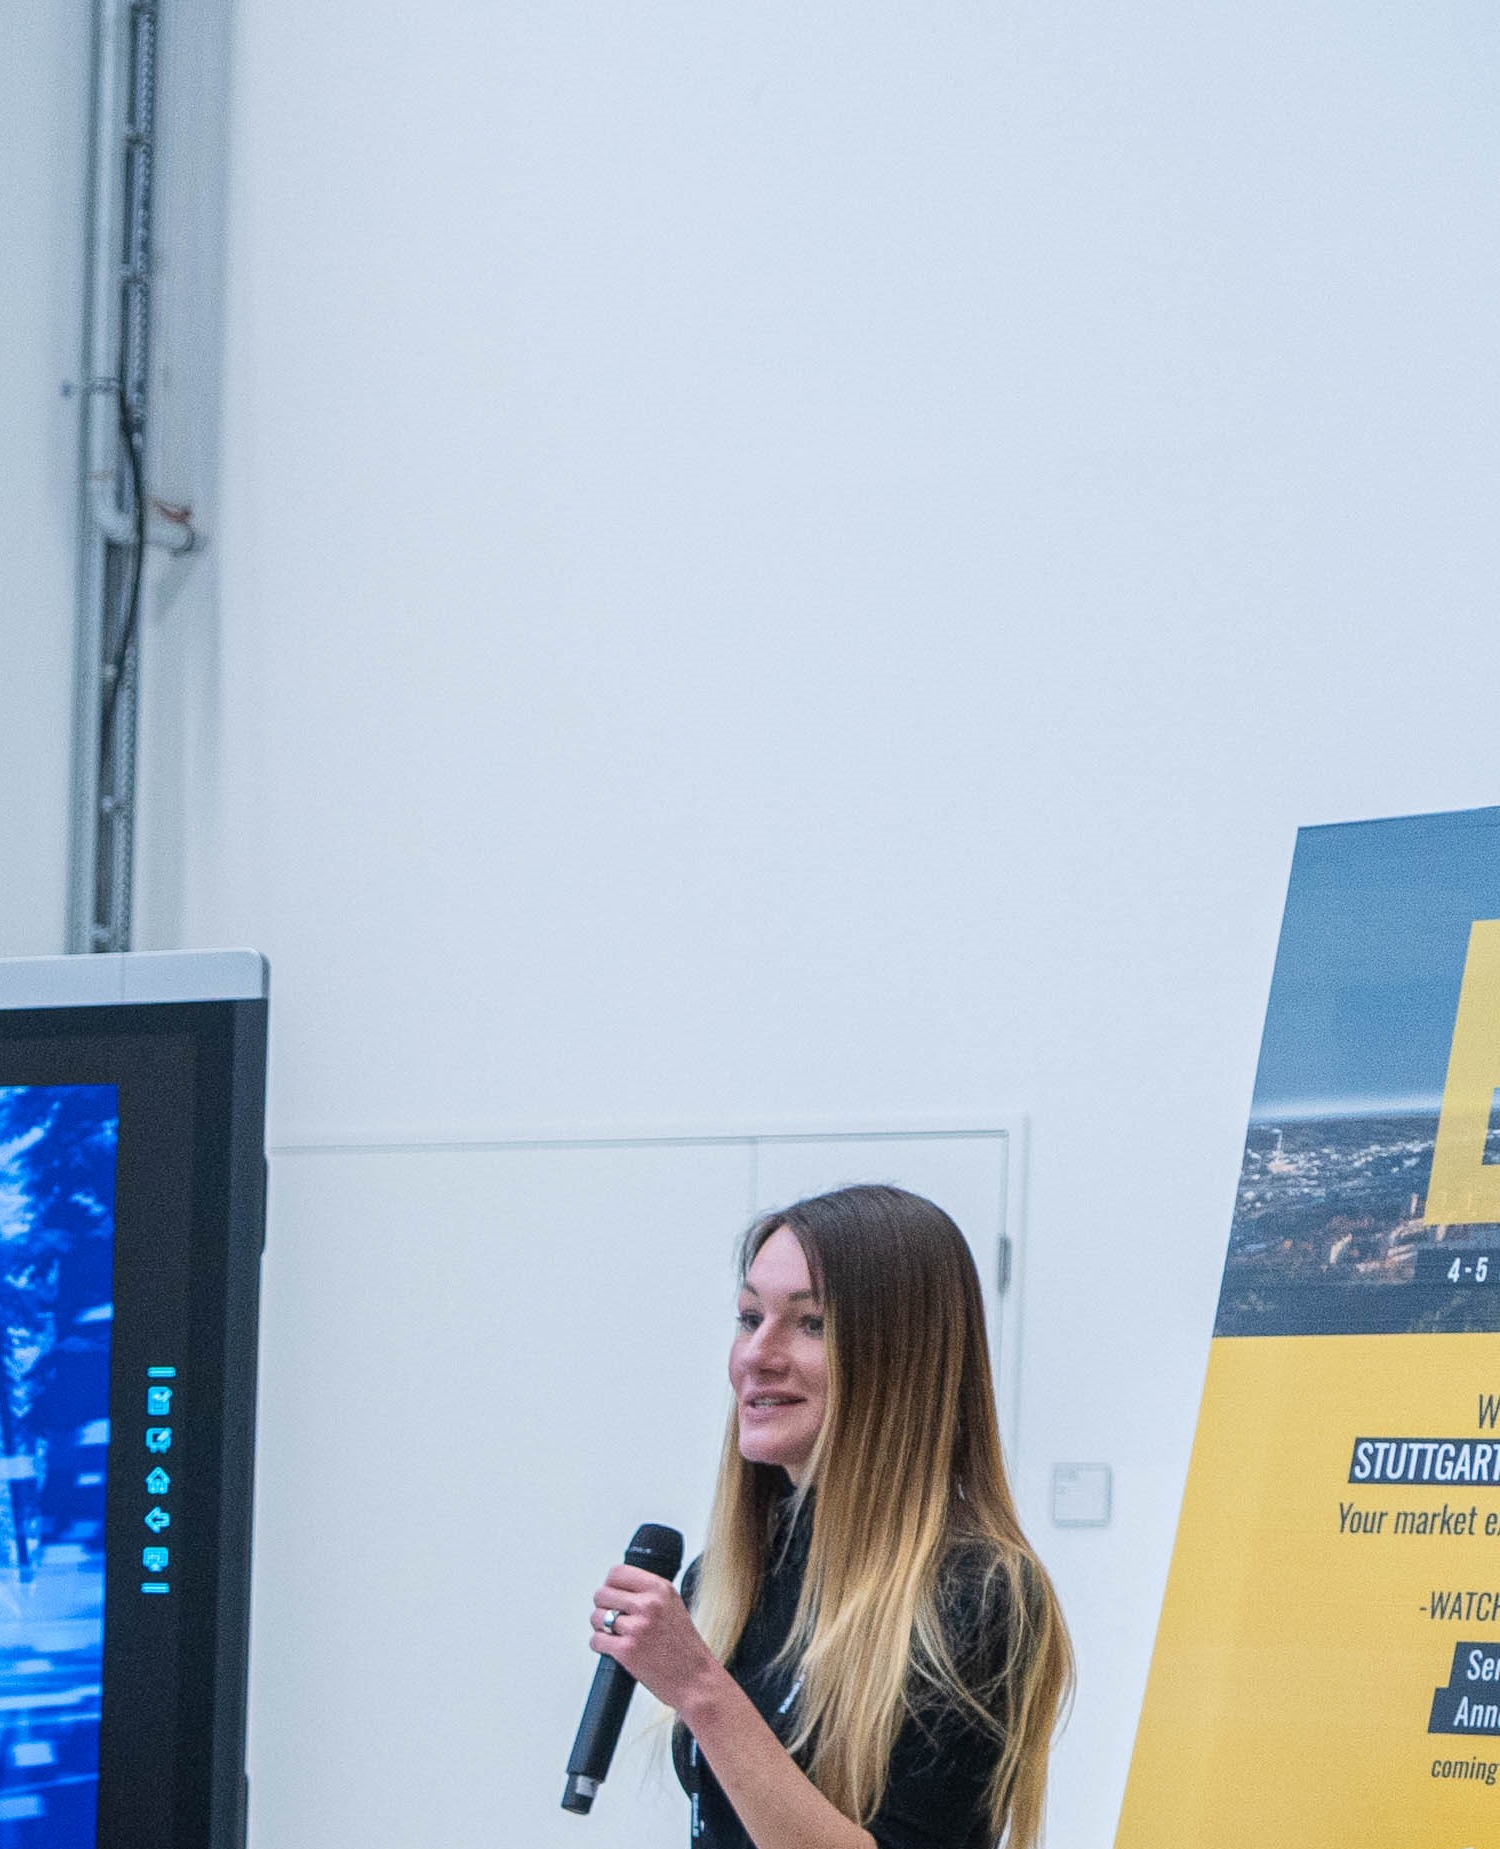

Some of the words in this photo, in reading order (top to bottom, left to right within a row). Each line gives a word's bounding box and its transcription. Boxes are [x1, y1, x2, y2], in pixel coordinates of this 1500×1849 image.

[1447, 1257, 1488, 1284] 4-5
[1339, 1502, 1388, 1534] Your
[1394, 1503, 1478, 1536] market
[1431, 1756, 1498, 1786] coming
